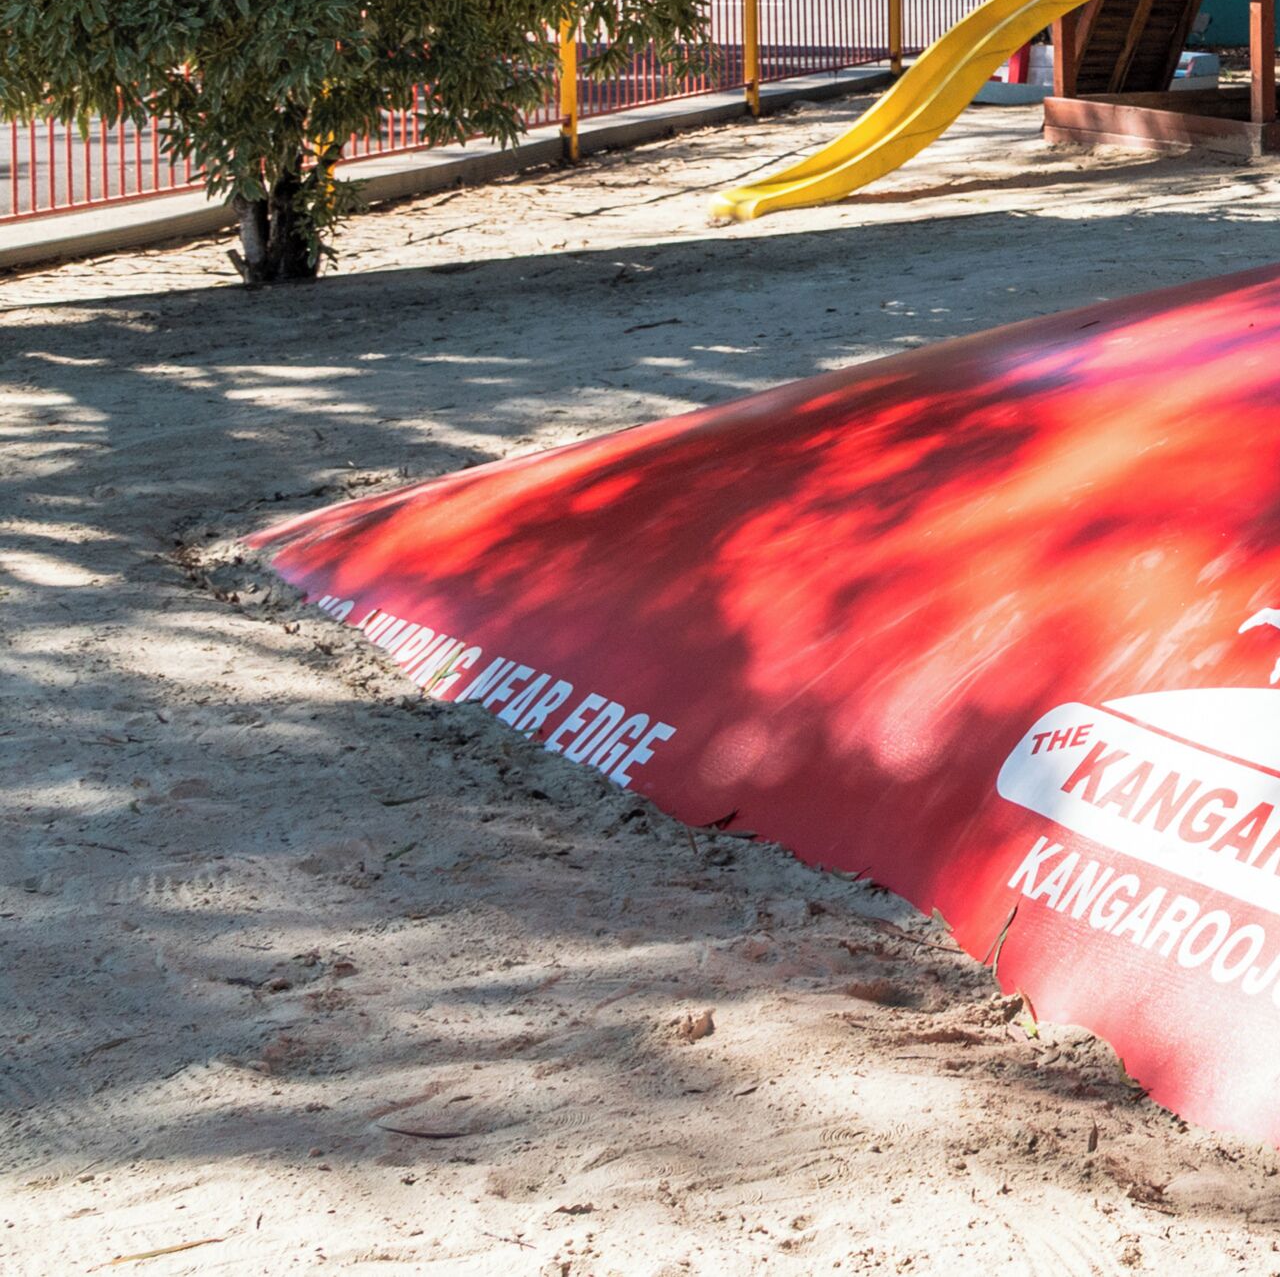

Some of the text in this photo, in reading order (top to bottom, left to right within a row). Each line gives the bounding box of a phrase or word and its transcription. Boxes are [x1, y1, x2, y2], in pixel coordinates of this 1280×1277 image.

[454, 657, 573, 739] NEAR
[544, 692, 677, 788] EDGE
[1031, 723, 1094, 755] THE
